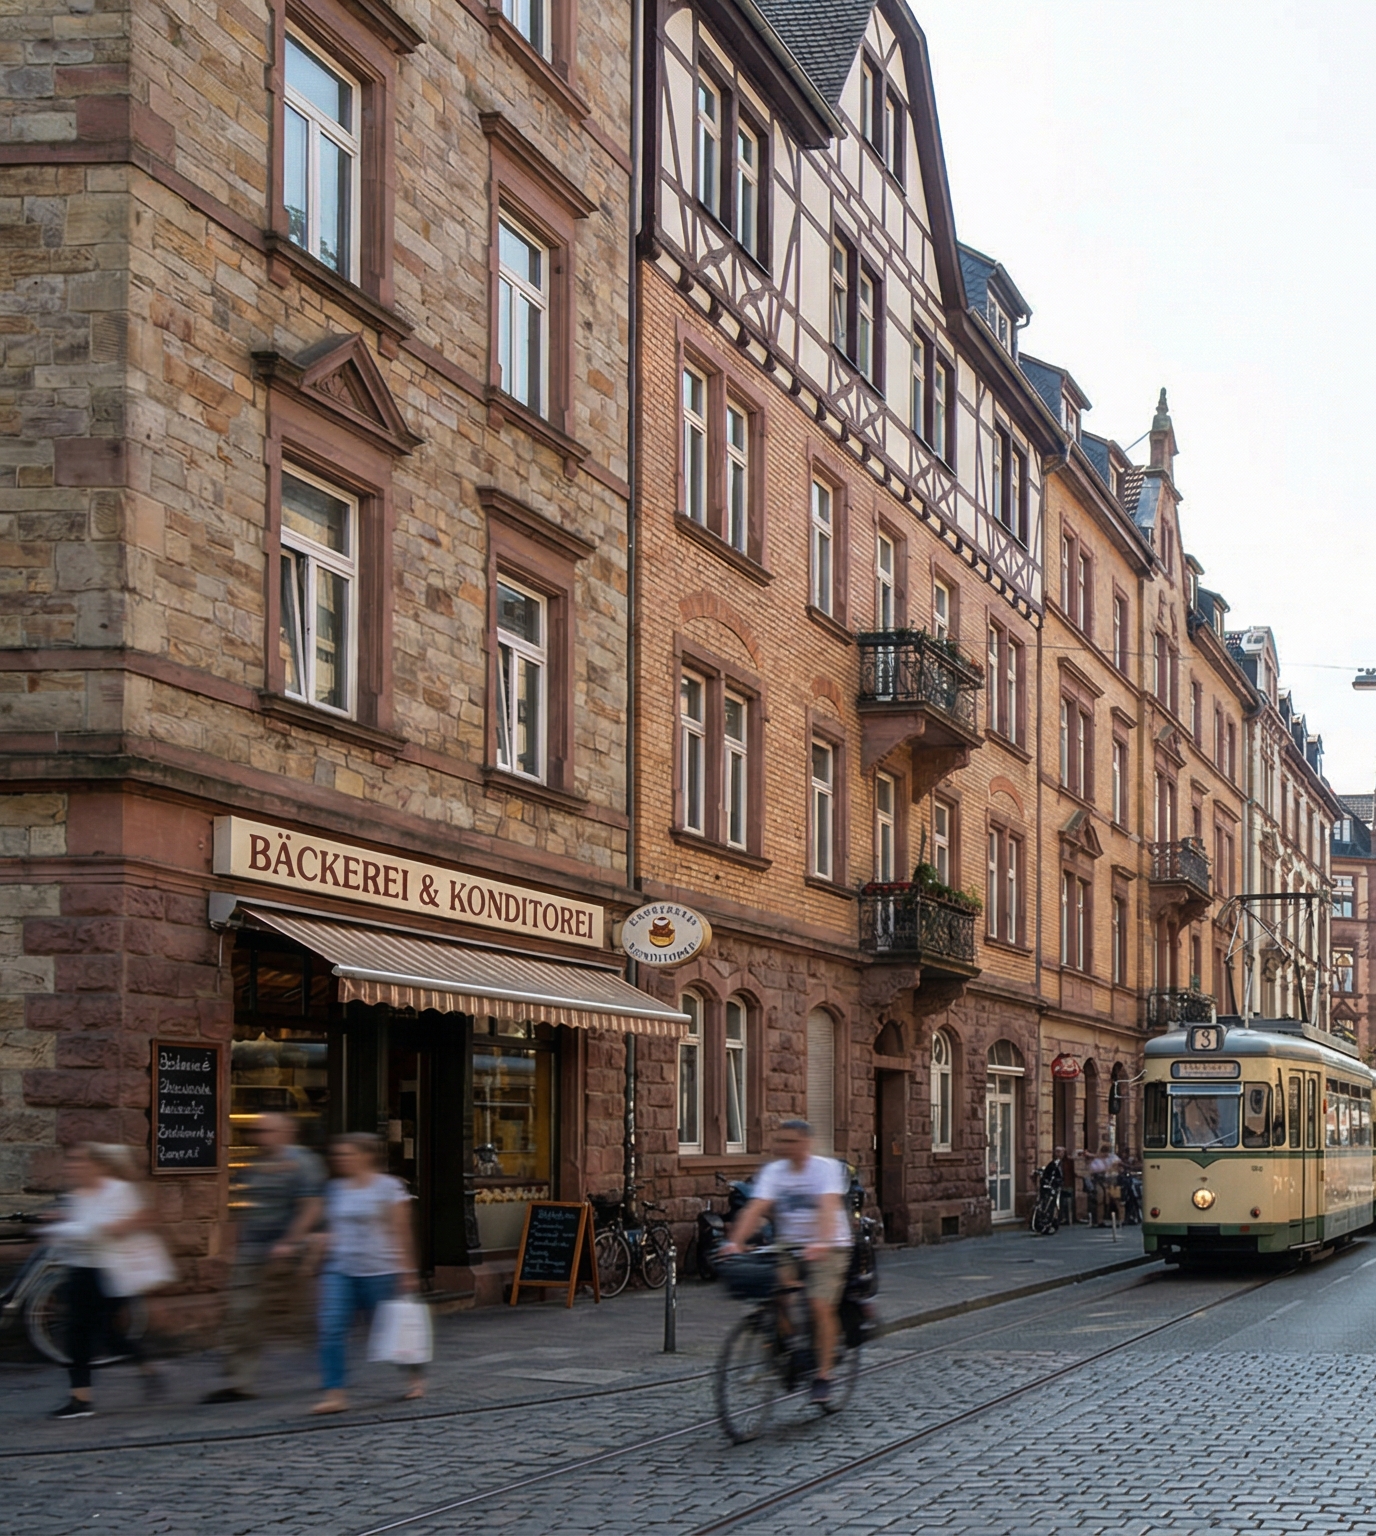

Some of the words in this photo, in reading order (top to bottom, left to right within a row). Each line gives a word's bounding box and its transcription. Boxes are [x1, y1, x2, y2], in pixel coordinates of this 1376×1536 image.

[248, 832, 410, 902] BÄCKEREI
[418, 873, 440, 908] &
[449, 879, 594, 940] KONDITOREI
